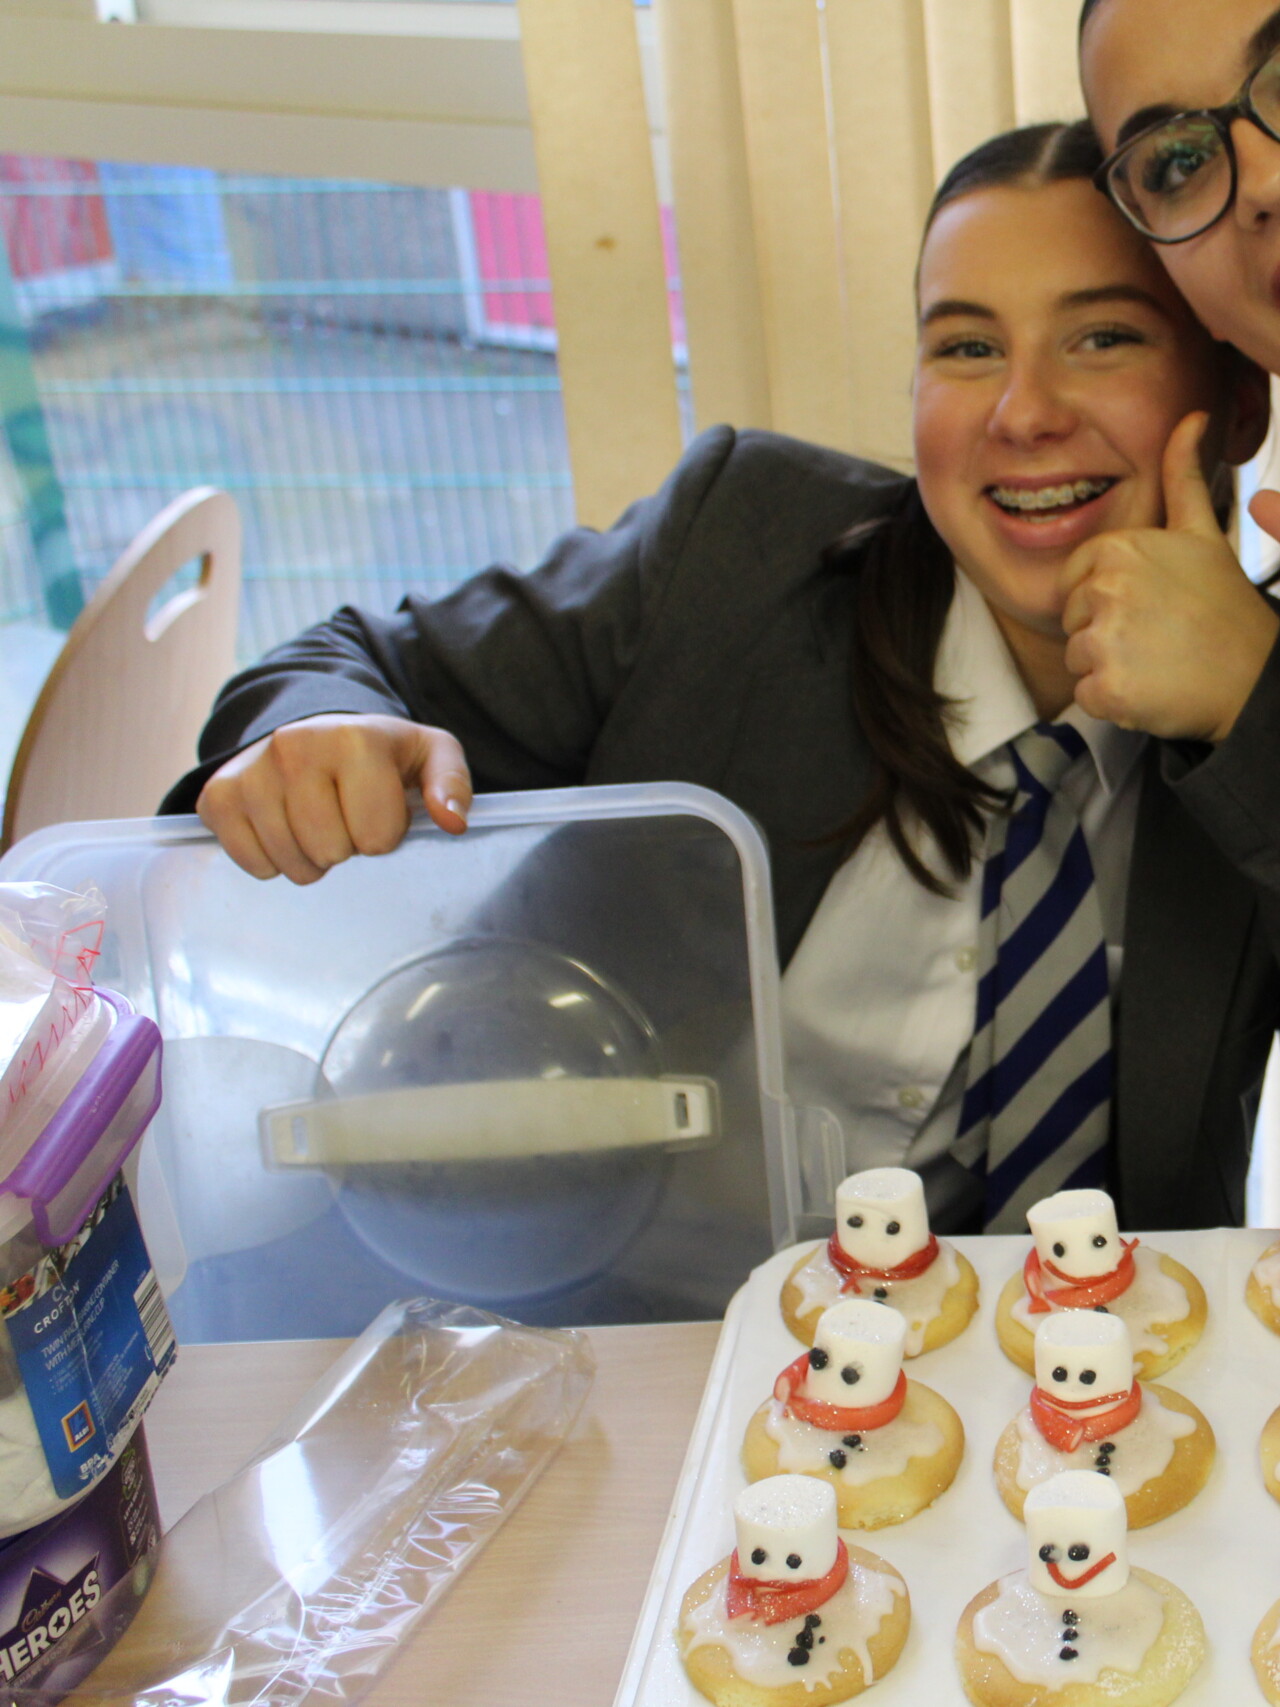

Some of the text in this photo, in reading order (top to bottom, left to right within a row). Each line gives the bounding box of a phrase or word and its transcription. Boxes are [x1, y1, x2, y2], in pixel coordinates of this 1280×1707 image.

[33, 1282, 79, 1334] CROFTON
[63, 1320, 79, 1341] PAC
[74, 1426, 90, 1442] ALDI
[80, 1453, 101, 1474] BPA
[0, 1570, 101, 1682] HEROES
